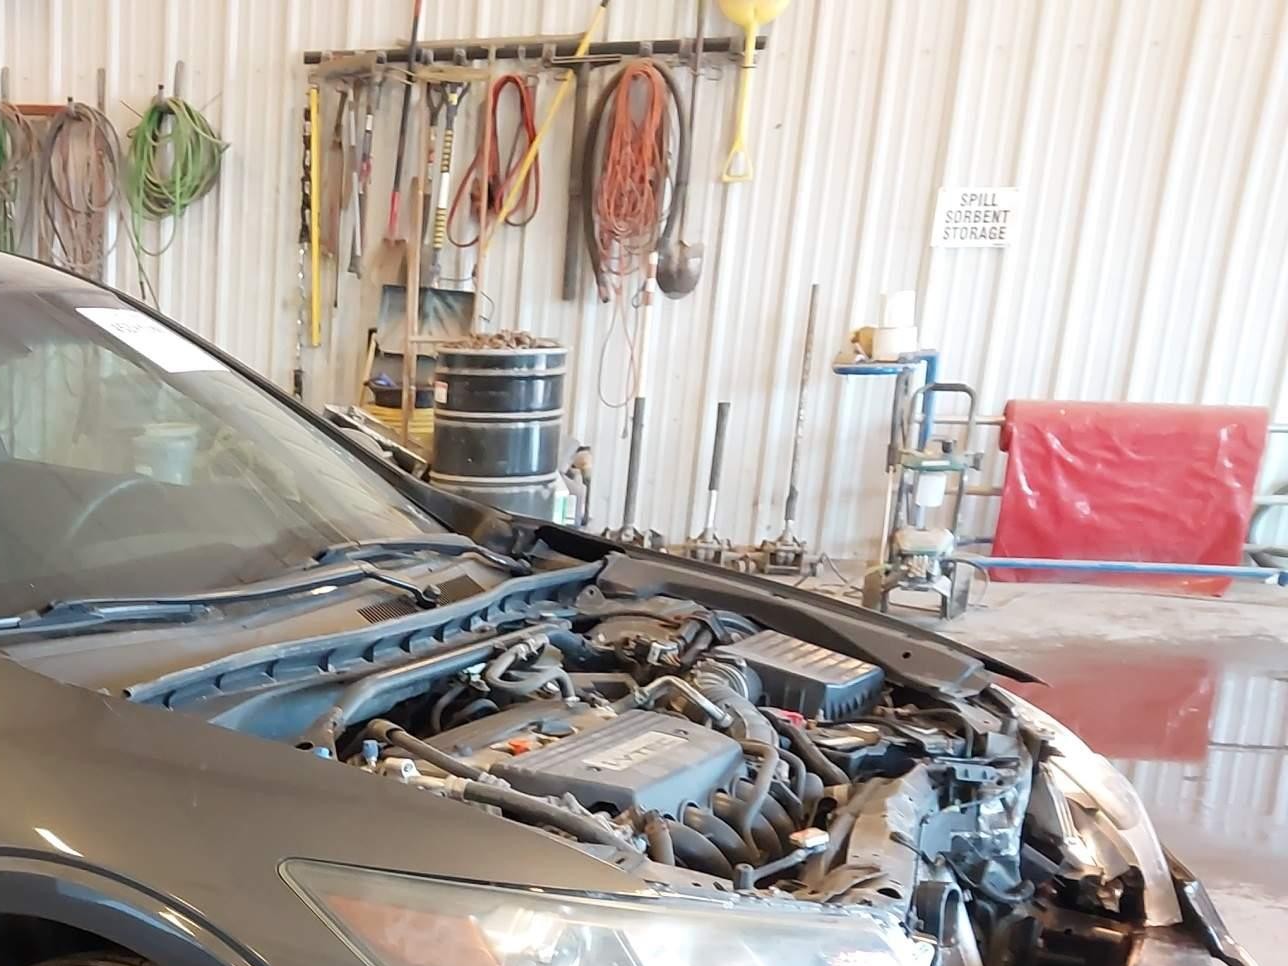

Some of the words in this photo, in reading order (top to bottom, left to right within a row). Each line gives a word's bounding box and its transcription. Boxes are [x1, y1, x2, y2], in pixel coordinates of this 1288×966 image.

[960, 193, 998, 207] SPILL
[945, 209, 1011, 223] SORBENT
[942, 226, 1007, 240] STORAGE
